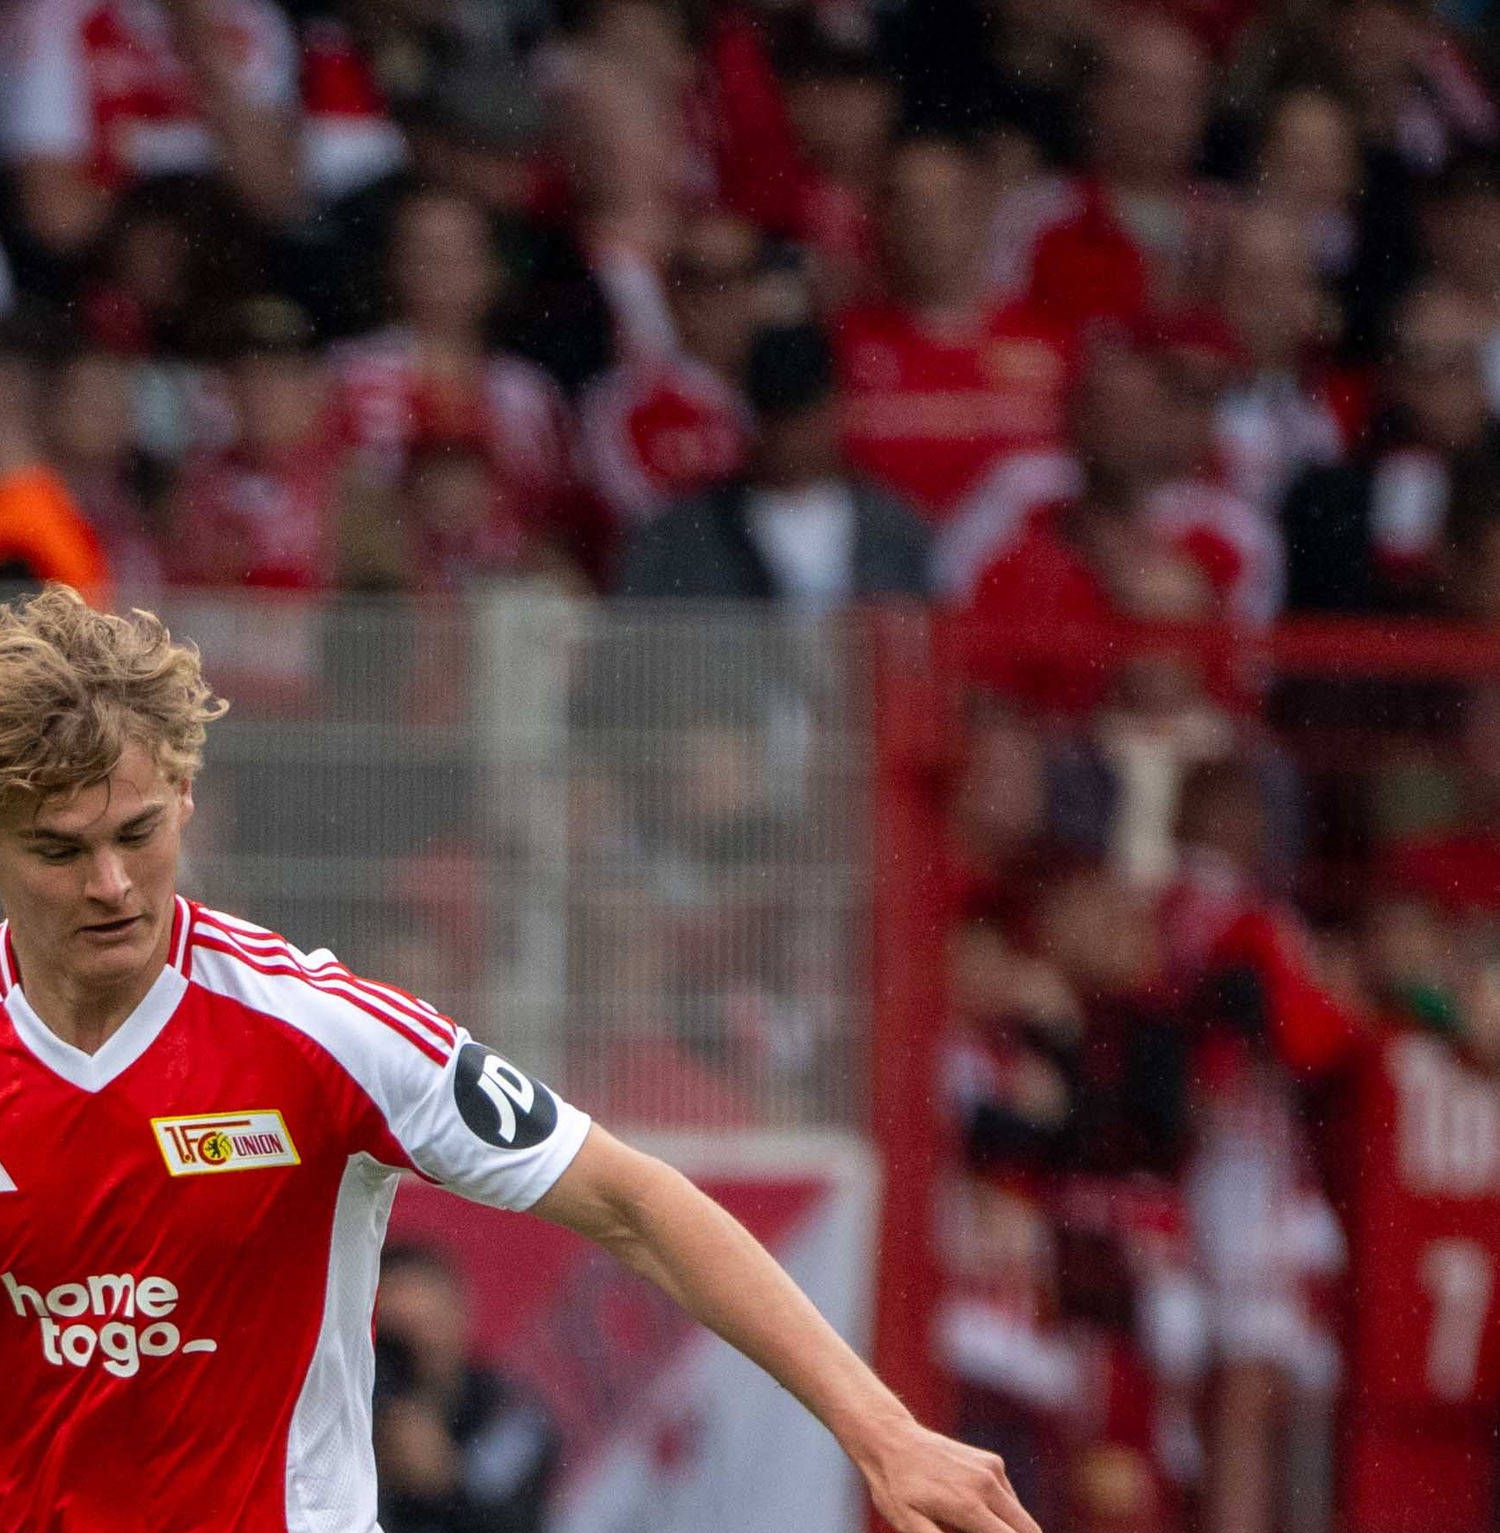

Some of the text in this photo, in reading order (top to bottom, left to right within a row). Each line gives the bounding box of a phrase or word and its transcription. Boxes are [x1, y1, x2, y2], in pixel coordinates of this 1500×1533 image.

[477, 1054, 535, 1144] JD
[232, 1133, 285, 1158] UNION
[0, 1271, 180, 1318] home
